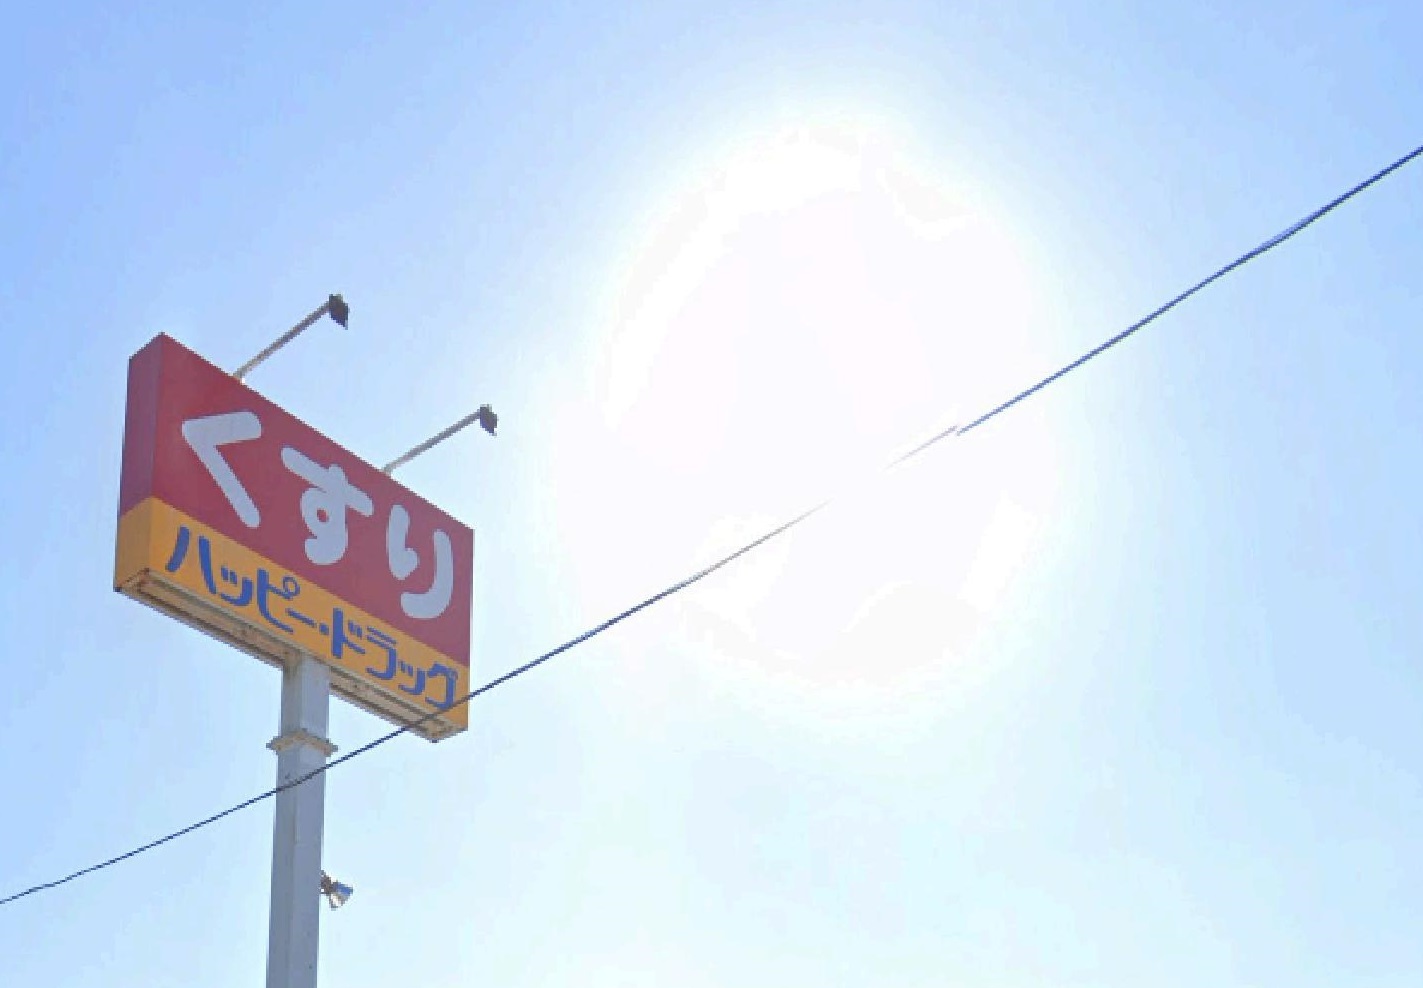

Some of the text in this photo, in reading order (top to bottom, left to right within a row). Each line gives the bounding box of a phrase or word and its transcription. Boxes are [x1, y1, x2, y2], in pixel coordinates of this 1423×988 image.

[181, 411, 454, 619] くすり
[165, 525, 460, 711] ハッピー・ドラッグ
